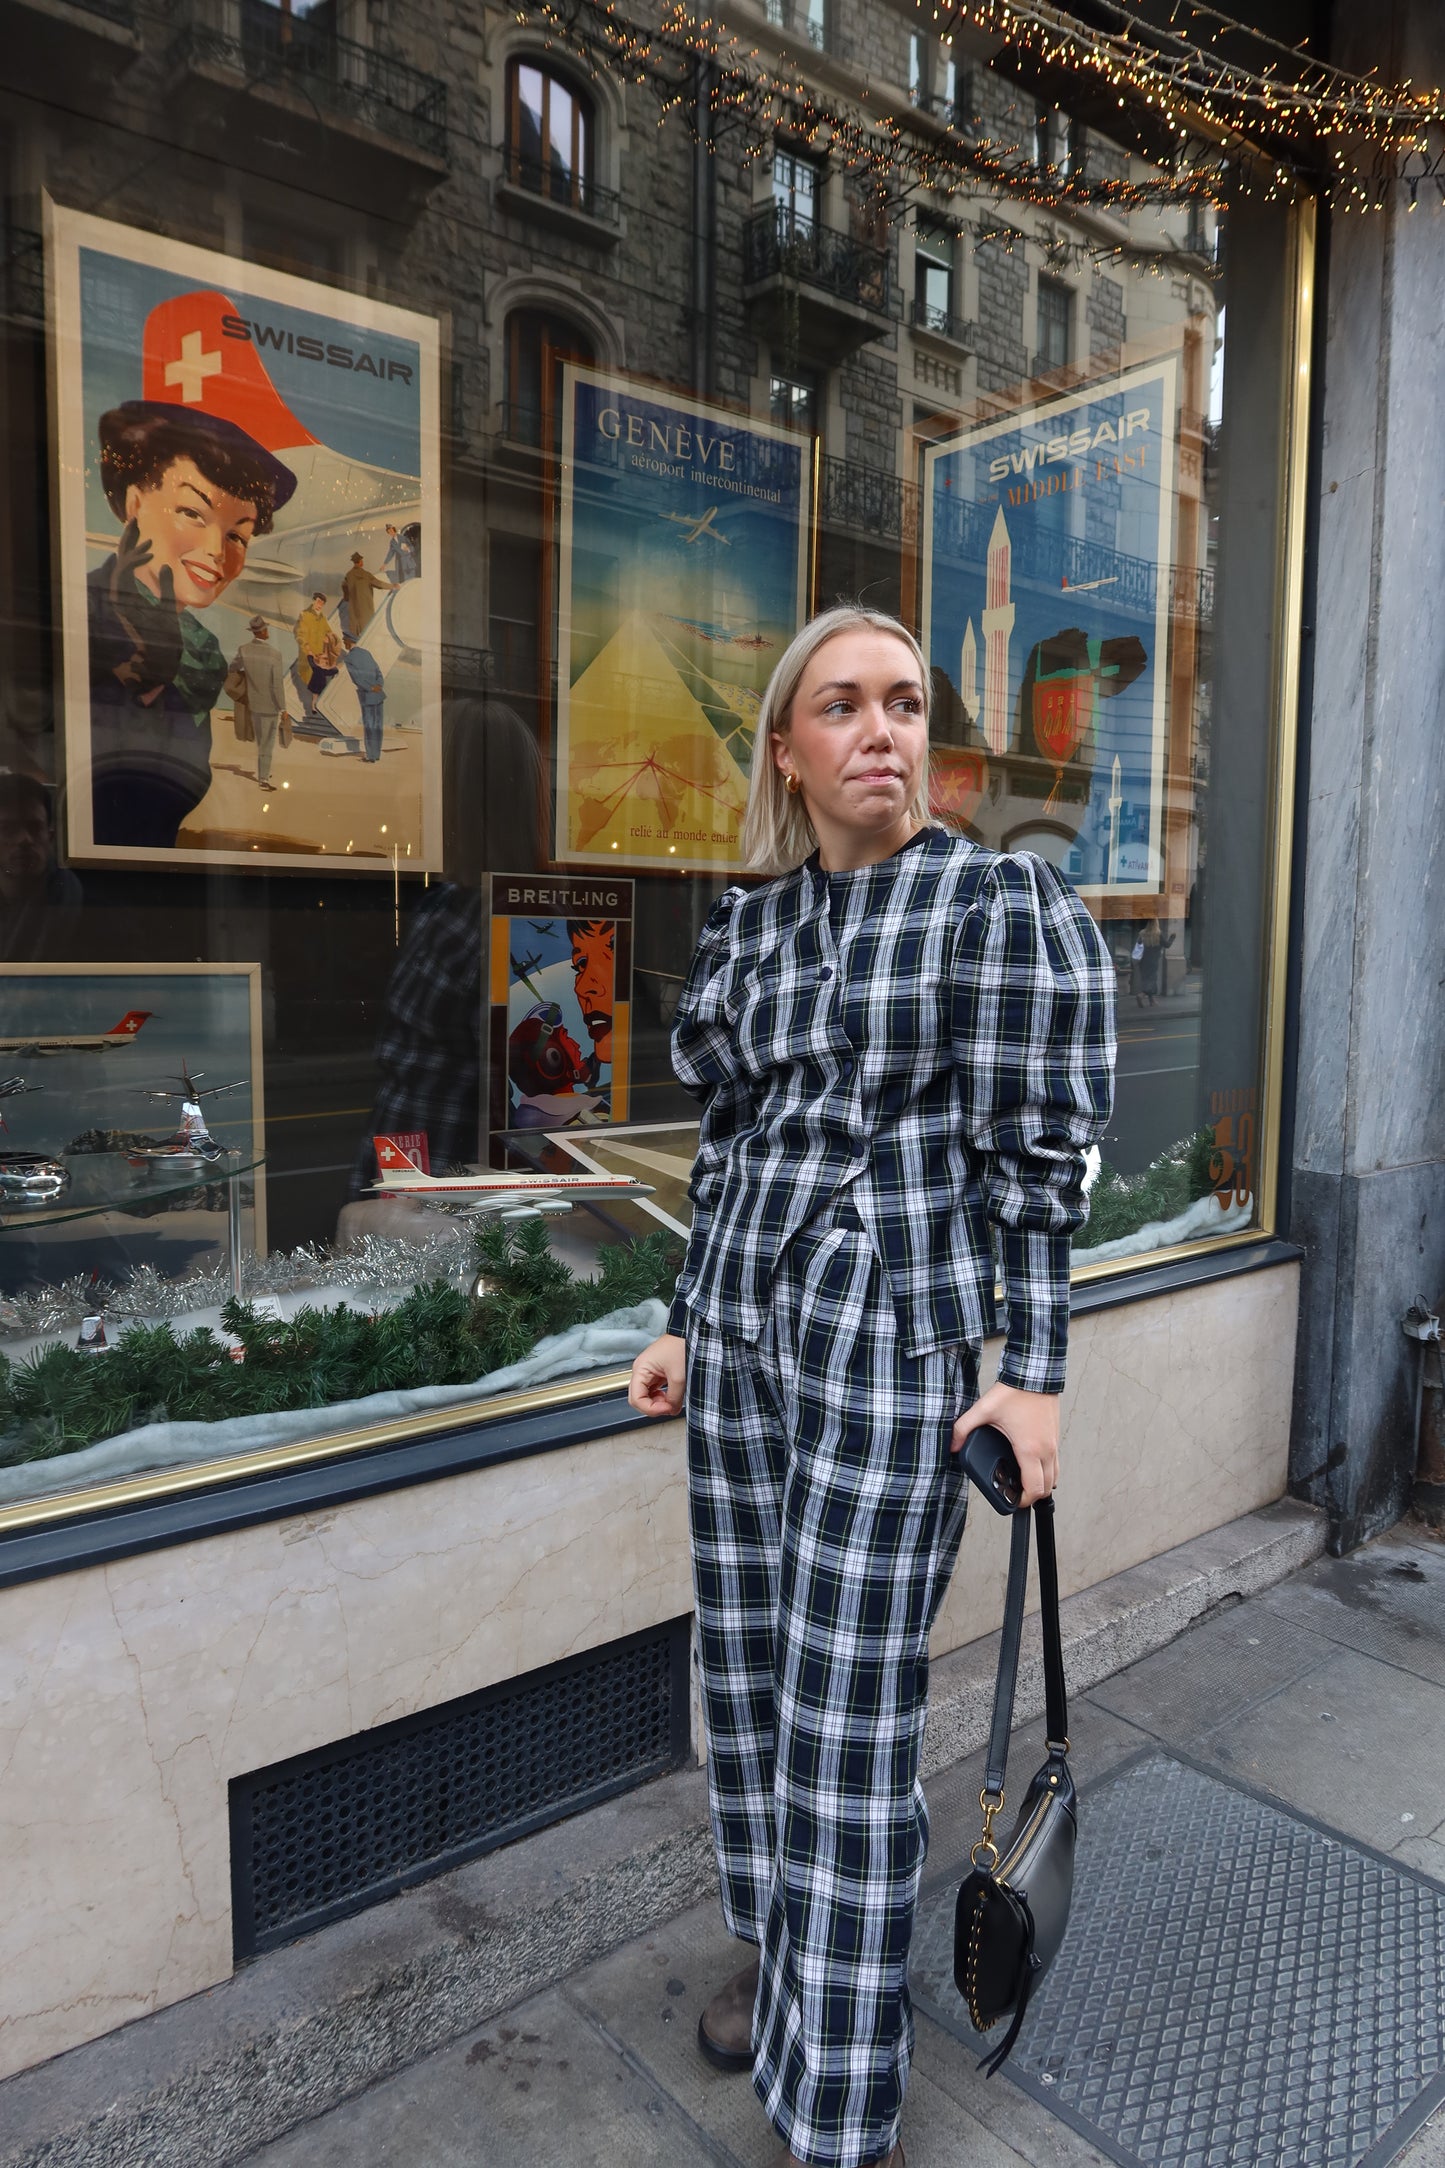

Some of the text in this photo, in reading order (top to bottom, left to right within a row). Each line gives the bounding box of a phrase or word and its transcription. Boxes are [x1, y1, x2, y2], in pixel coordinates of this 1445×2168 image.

[221, 314, 413, 385] SWISSAIR
[597, 408, 736, 472] GENÈVE
[989, 408, 1151, 482] SWISSAIR
[631, 452, 781, 504] aéroport intercontinental
[1007, 444, 1150, 508] MIDDLE EAST
[630, 825, 653, 838] relié
[656, 829, 669, 839] au
[673, 829, 707, 842] monde
[507, 887, 619, 907] BREITLING
[391, 1133, 421, 1149] LERIE
[519, 1177, 580, 1185] SWISSAIR
